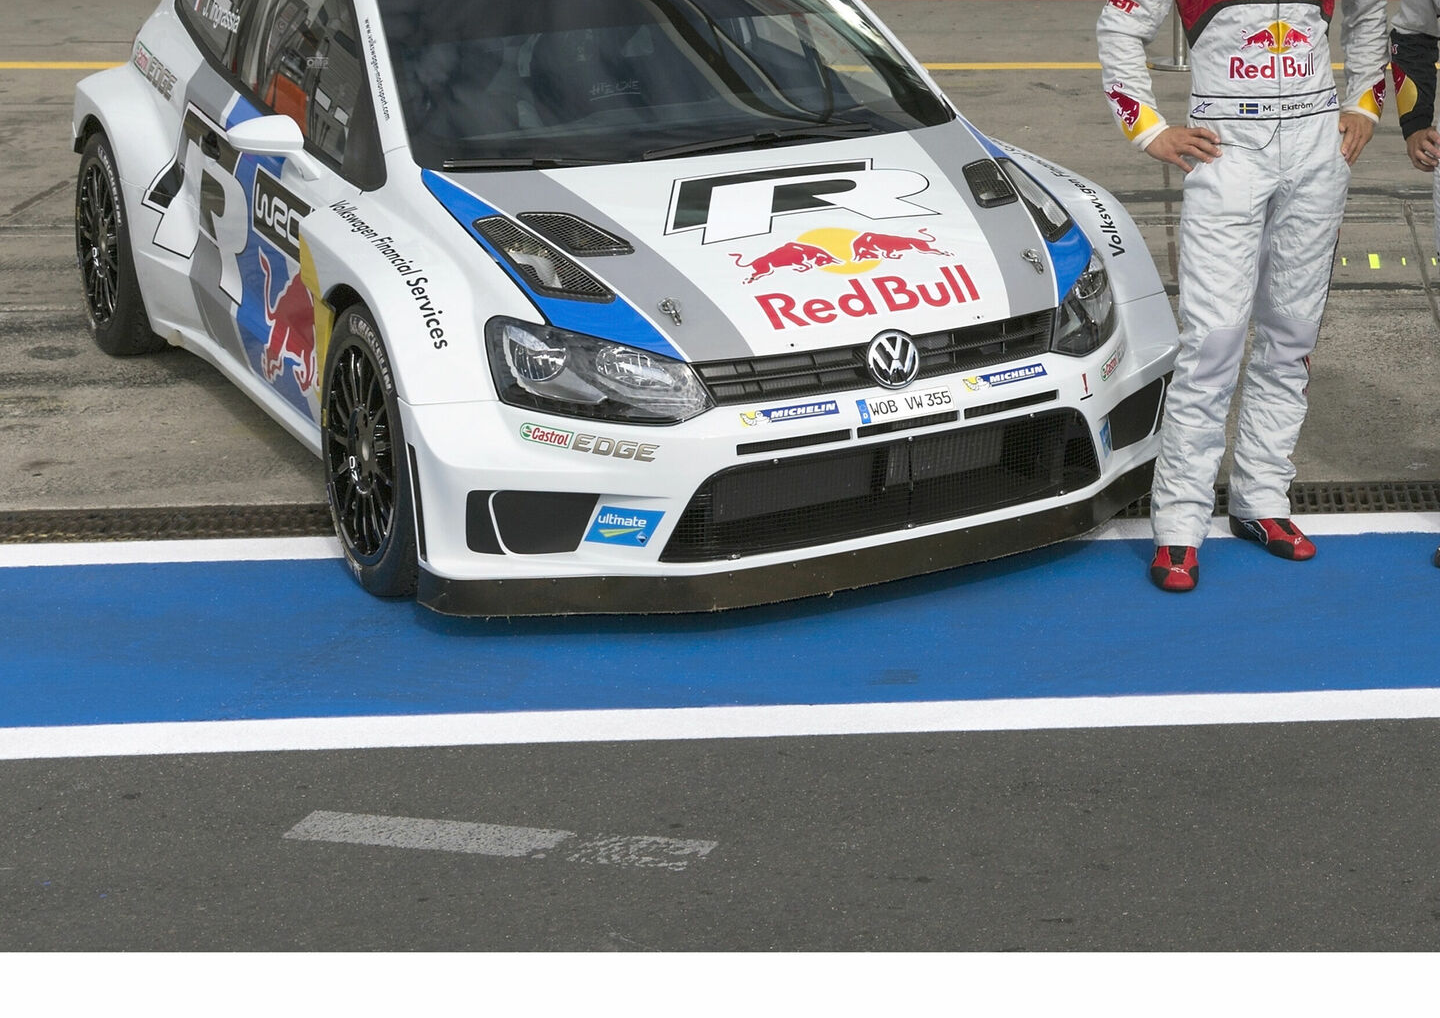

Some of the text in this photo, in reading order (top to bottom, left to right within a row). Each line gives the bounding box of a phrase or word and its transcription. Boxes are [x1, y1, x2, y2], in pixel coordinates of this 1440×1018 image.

[1229, 52, 1315, 79] Red Bull
[1262, 102, 1314, 112] M. Ekström
[1068, 178, 1126, 258] Volkswagen
[329, 199, 448, 350] Volkswagen Financial Services
[754, 263, 981, 331] Red Bull
[989, 365, 1044, 384] MICHELIN
[769, 402, 837, 420] MICHELIN
[869, 399, 899, 417] WOB
[904, 395, 924, 411] VW
[924, 390, 952, 408] 355
[531, 426, 660, 463] Castrol EDGE
[598, 512, 648, 529] ultimate
